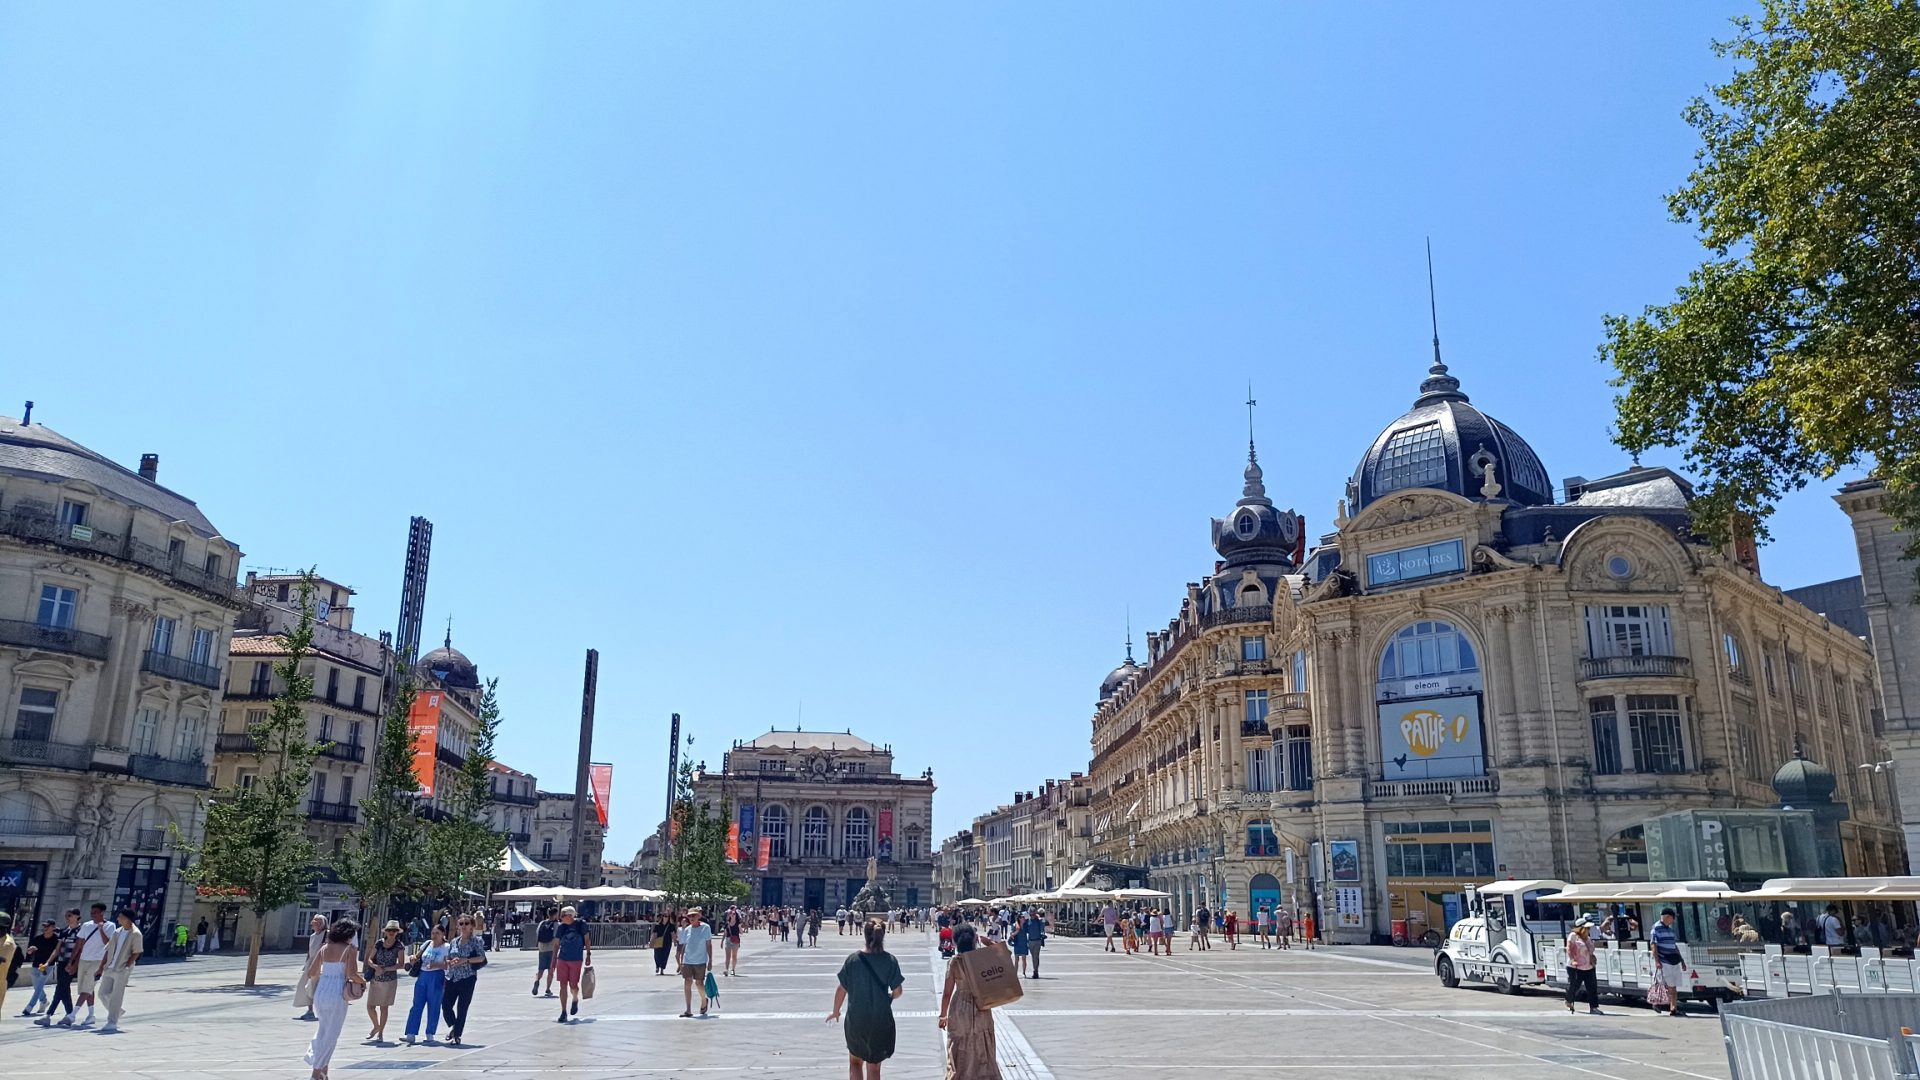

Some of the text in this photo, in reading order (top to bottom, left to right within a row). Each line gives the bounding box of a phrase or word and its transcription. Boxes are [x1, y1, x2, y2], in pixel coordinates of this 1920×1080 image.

[1399, 553, 1452, 571] NOTAIRES
[1414, 681, 1439, 690] eleom
[980, 966, 1004, 978] celio
